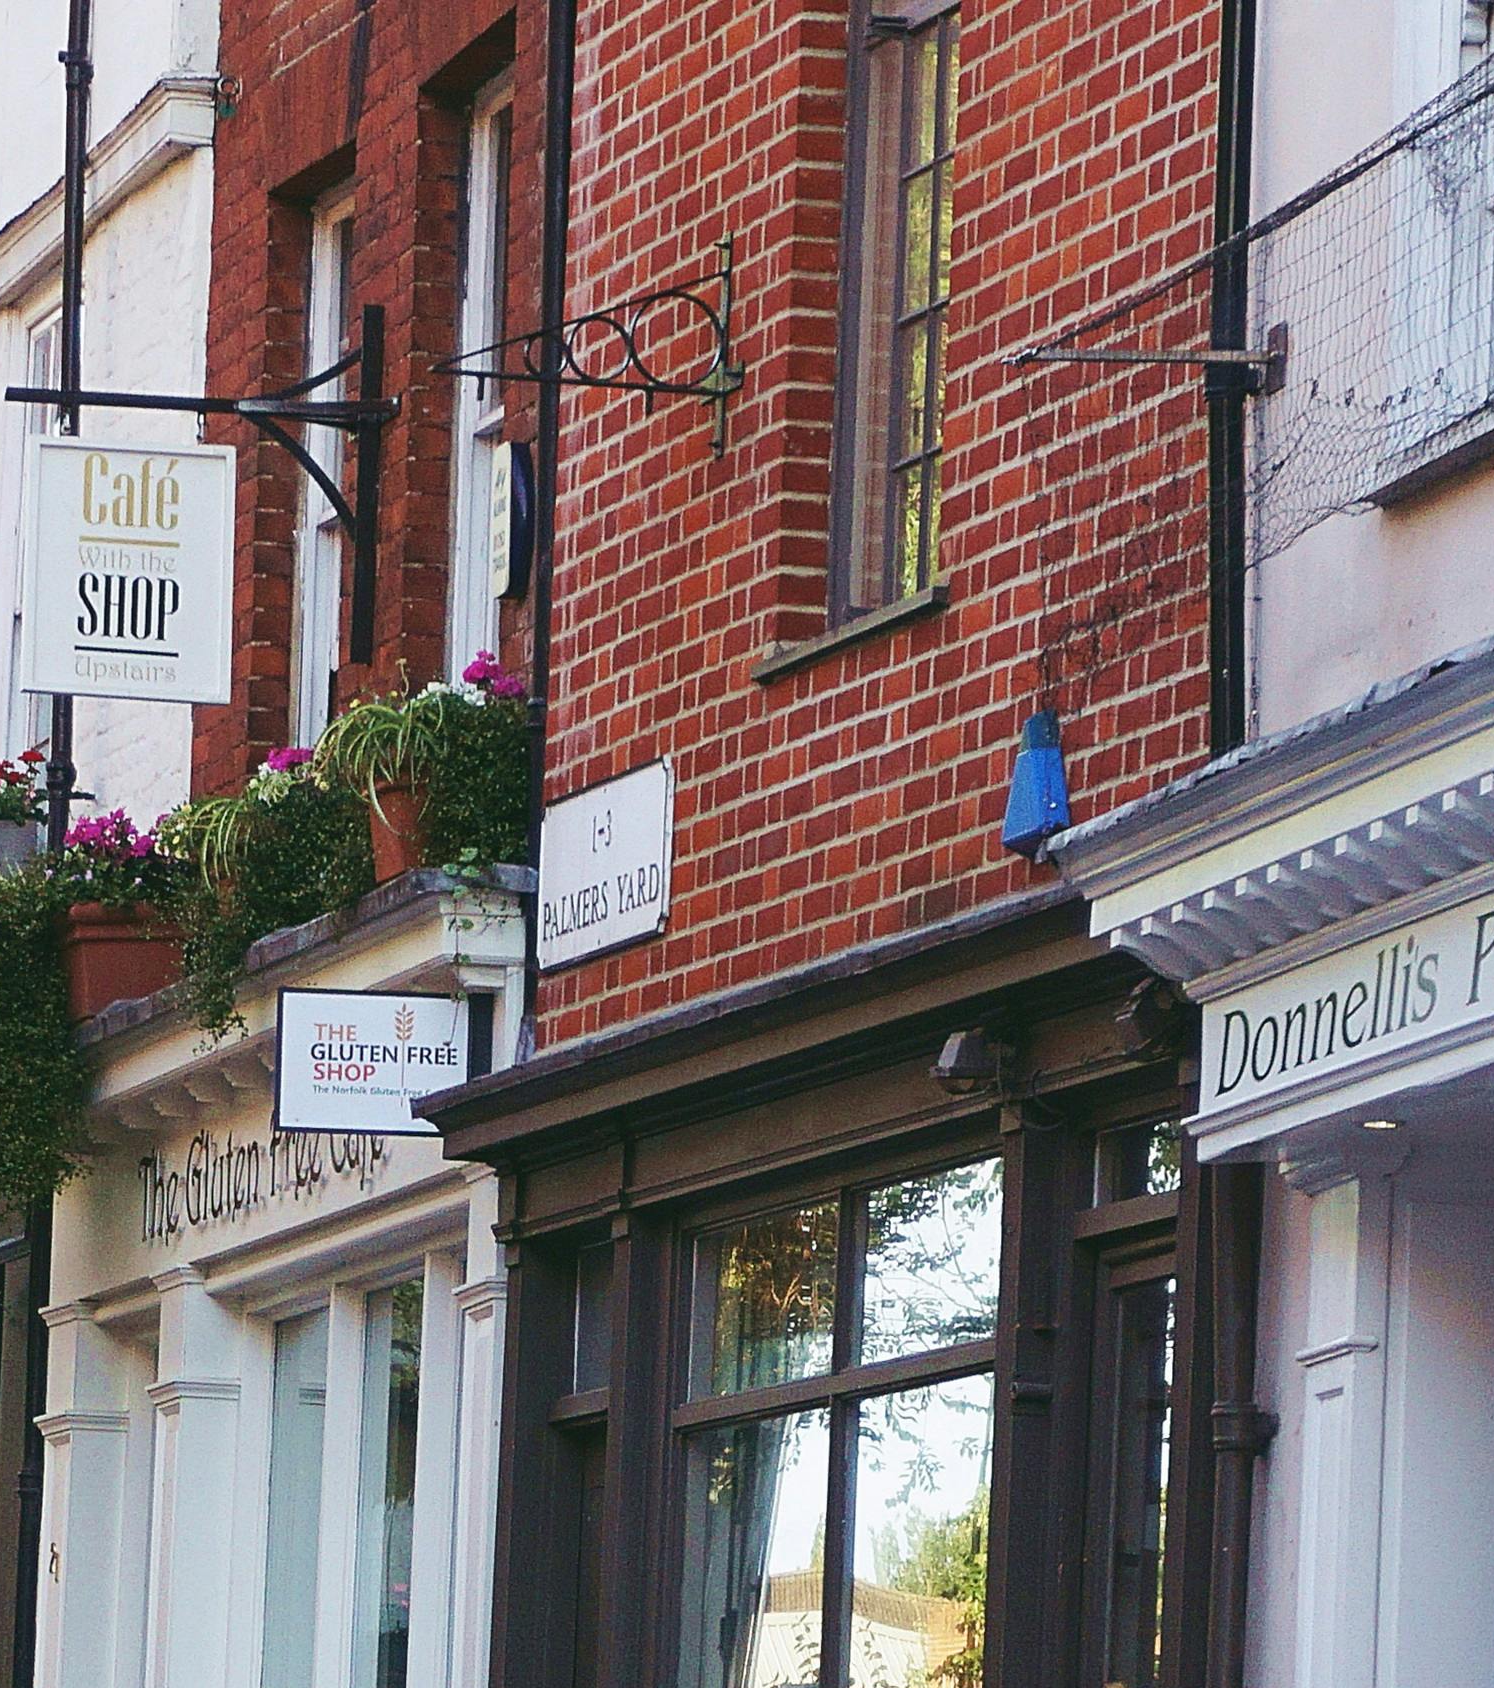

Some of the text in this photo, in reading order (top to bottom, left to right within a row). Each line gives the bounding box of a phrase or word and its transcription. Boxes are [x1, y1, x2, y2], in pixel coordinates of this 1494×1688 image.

[82, 452, 179, 531] Café
[78, 546, 177, 574] With the
[77, 572, 179, 641] SHOP
[75, 655, 177, 683] Upstairs
[592, 809, 612, 853] 1-3
[543, 863, 660, 942] PALMERS YARD
[314, 1023, 357, 1042] THE
[1215, 935, 1438, 1099] Donnelli's
[311, 1043, 458, 1066] GLUTEN FREE
[313, 1063, 376, 1082] SHOP
[313, 1085, 330, 1094] The
[332, 1085, 367, 1095] Norfolk
[370, 1087, 400, 1097] Gluten
[138, 1146, 179, 1246] The
[185, 1128, 259, 1226] Gluten
